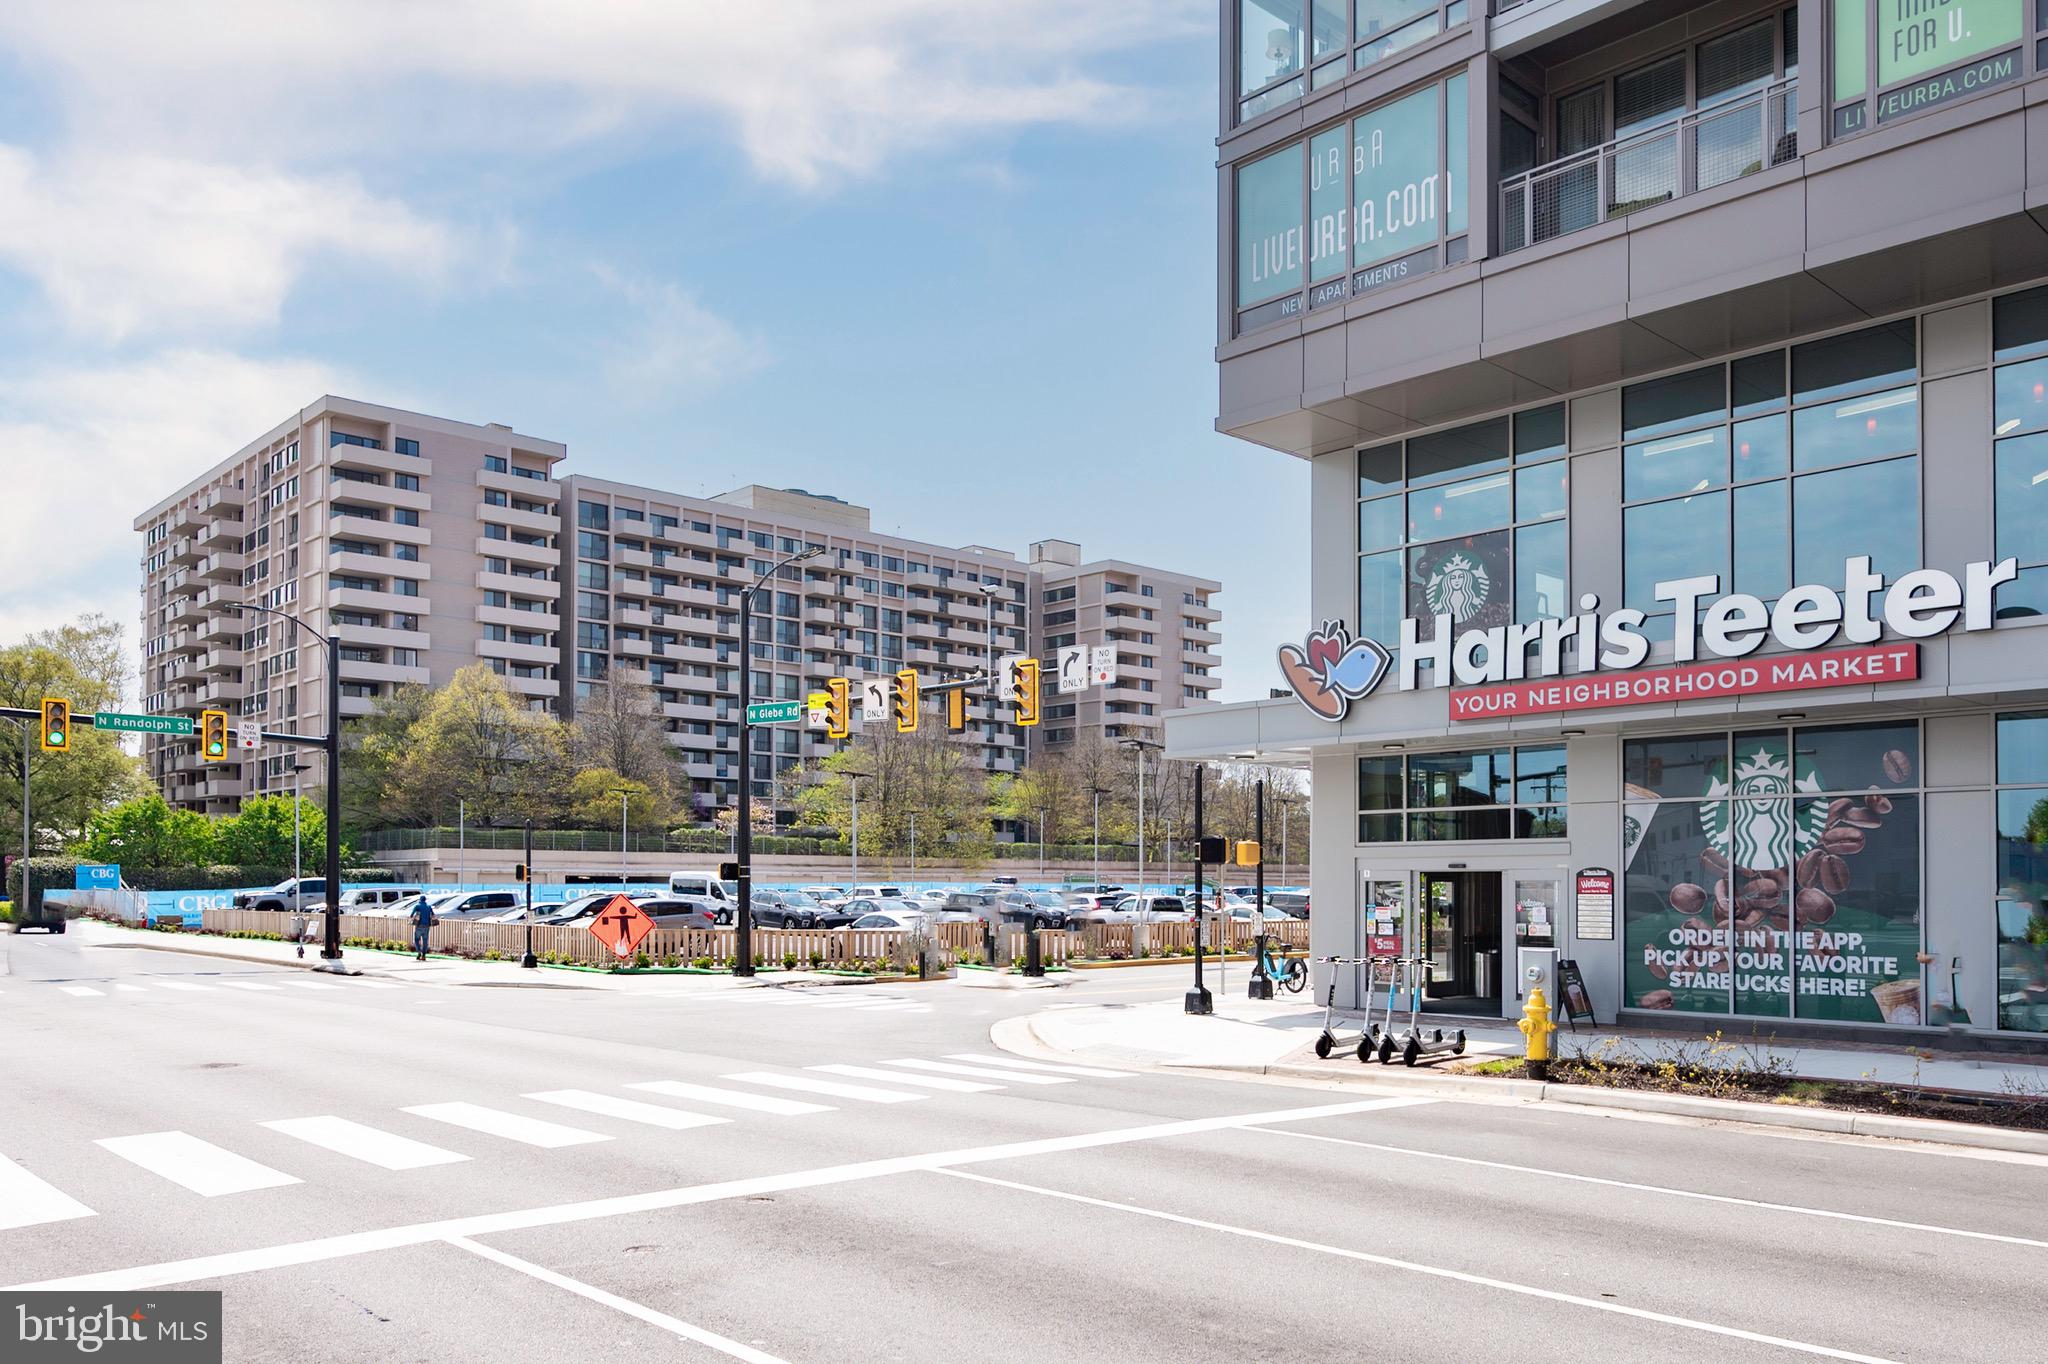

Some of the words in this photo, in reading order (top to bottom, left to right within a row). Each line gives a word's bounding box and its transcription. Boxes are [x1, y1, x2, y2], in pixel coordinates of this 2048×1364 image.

[1894, 18, 1937, 63] FOR
[1948, 7, 1971, 42] U.
[1845, 57, 2013, 129] LIVEURBA.COM
[1310, 129, 1384, 191] URBA
[1399, 593, 1651, 692] Harris
[1654, 554, 2018, 663] Teeter
[1098, 649, 1110, 657] NO
[1093, 666, 1102, 674] ON
[1062, 676, 1085, 689] ONLY
[1455, 692, 1518, 714] YOUR
[1528, 667, 1759, 708] NEIGHBORHOOD
[1772, 651, 1909, 685] MARKET
[749, 709, 756, 720] N
[759, 706, 784, 719] Glebe
[786, 706, 799, 717] Rd
[866, 709, 886, 718] ONLY
[98, 716, 107, 725] N
[113, 717, 172, 731] Randolph
[177, 721, 190, 731] St
[243, 723, 255, 731] NO
[91, 868, 114, 879] CBG
[178, 895, 227, 912] CBG
[1668, 928, 1740, 947] ORDER
[1743, 930, 1766, 948] IN
[1769, 930, 1815, 949] THE
[1818, 931, 1867, 955] APP,
[1644, 949, 1689, 967] PICK
[1692, 950, 1721, 968] UP
[1723, 950, 1785, 970] YOUR
[1795, 954, 1899, 976] FAVORITE
[1668, 970, 1792, 994] STARBUCKS
[1799, 976, 1867, 997] HERE!
